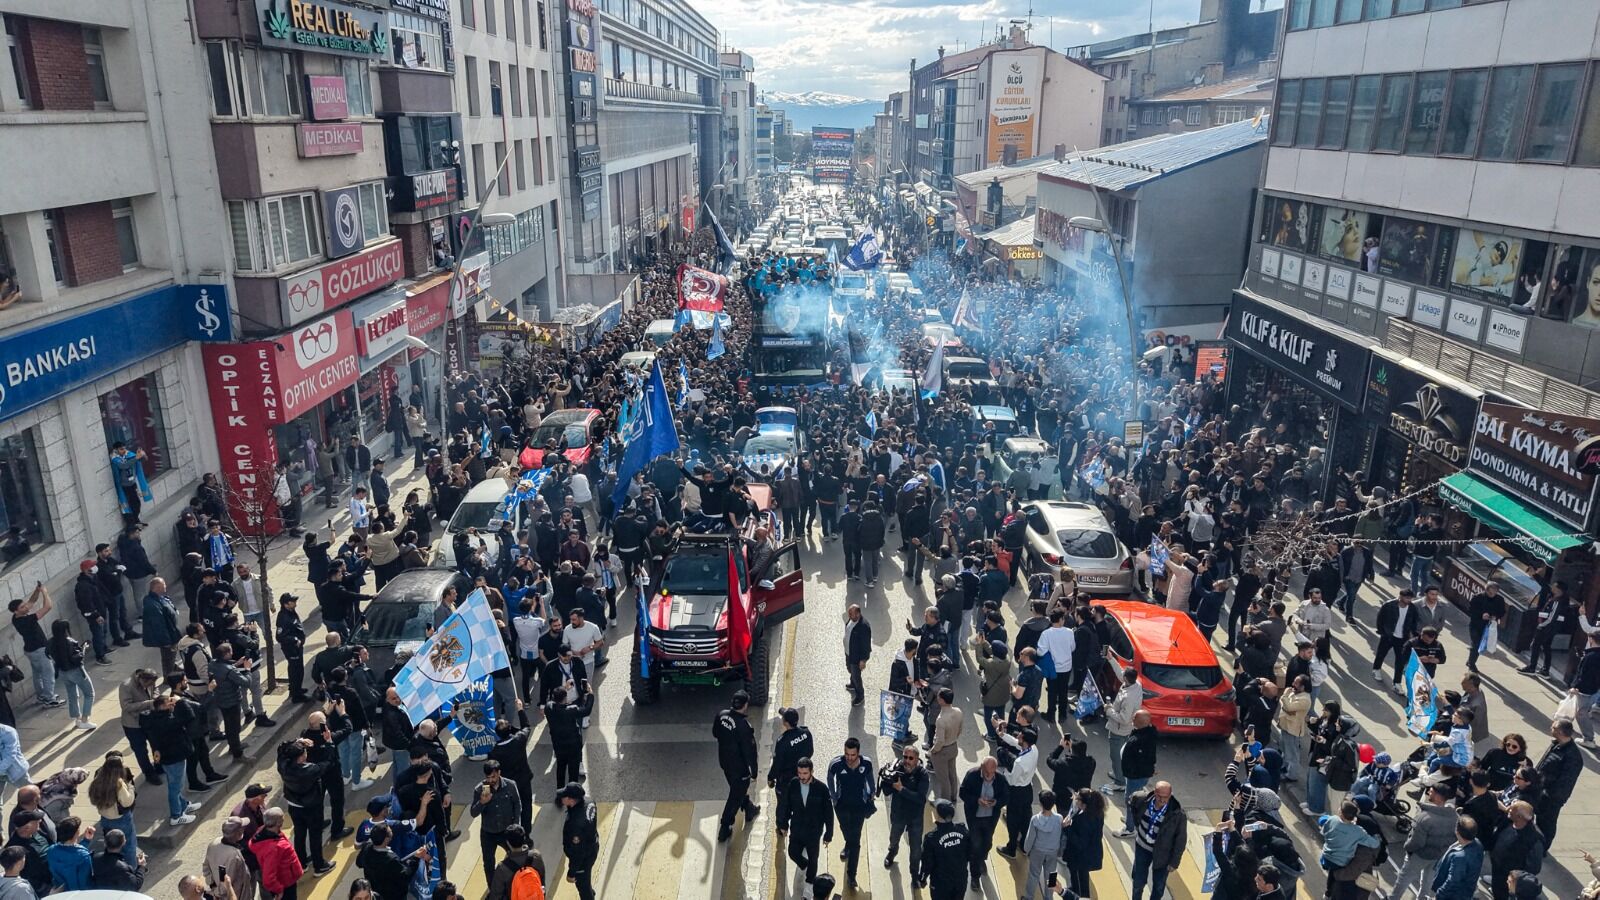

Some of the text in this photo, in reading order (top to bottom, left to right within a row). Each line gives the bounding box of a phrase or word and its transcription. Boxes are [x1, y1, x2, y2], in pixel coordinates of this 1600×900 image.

[290, 0, 334, 34] REAL
[335, 9, 361, 39] Life
[313, 84, 346, 104] MEDİKAL
[1007, 75, 1023, 84] ÖLÇÜ
[305, 127, 360, 145] MEDİKAL
[328, 247, 401, 299] GÖZLÜKÇÜ
[1418, 302, 1441, 316] Linkage
[1240, 310, 1315, 365] KILIF & KILIF
[1497, 323, 1521, 338] iPhone
[6, 335, 97, 387] BANKASI
[258, 349, 277, 420] ECZANE
[285, 355, 357, 410] OPTİK CENTER
[1316, 370, 1342, 391] PREMIUM
[1476, 411, 1582, 480] BAL KAYMA
[1440, 485, 1472, 511] BAL KAYMAK
[1473, 447, 1588, 516] DONDURMA & TATLI
[1515, 532, 1552, 560] DONDURMA
